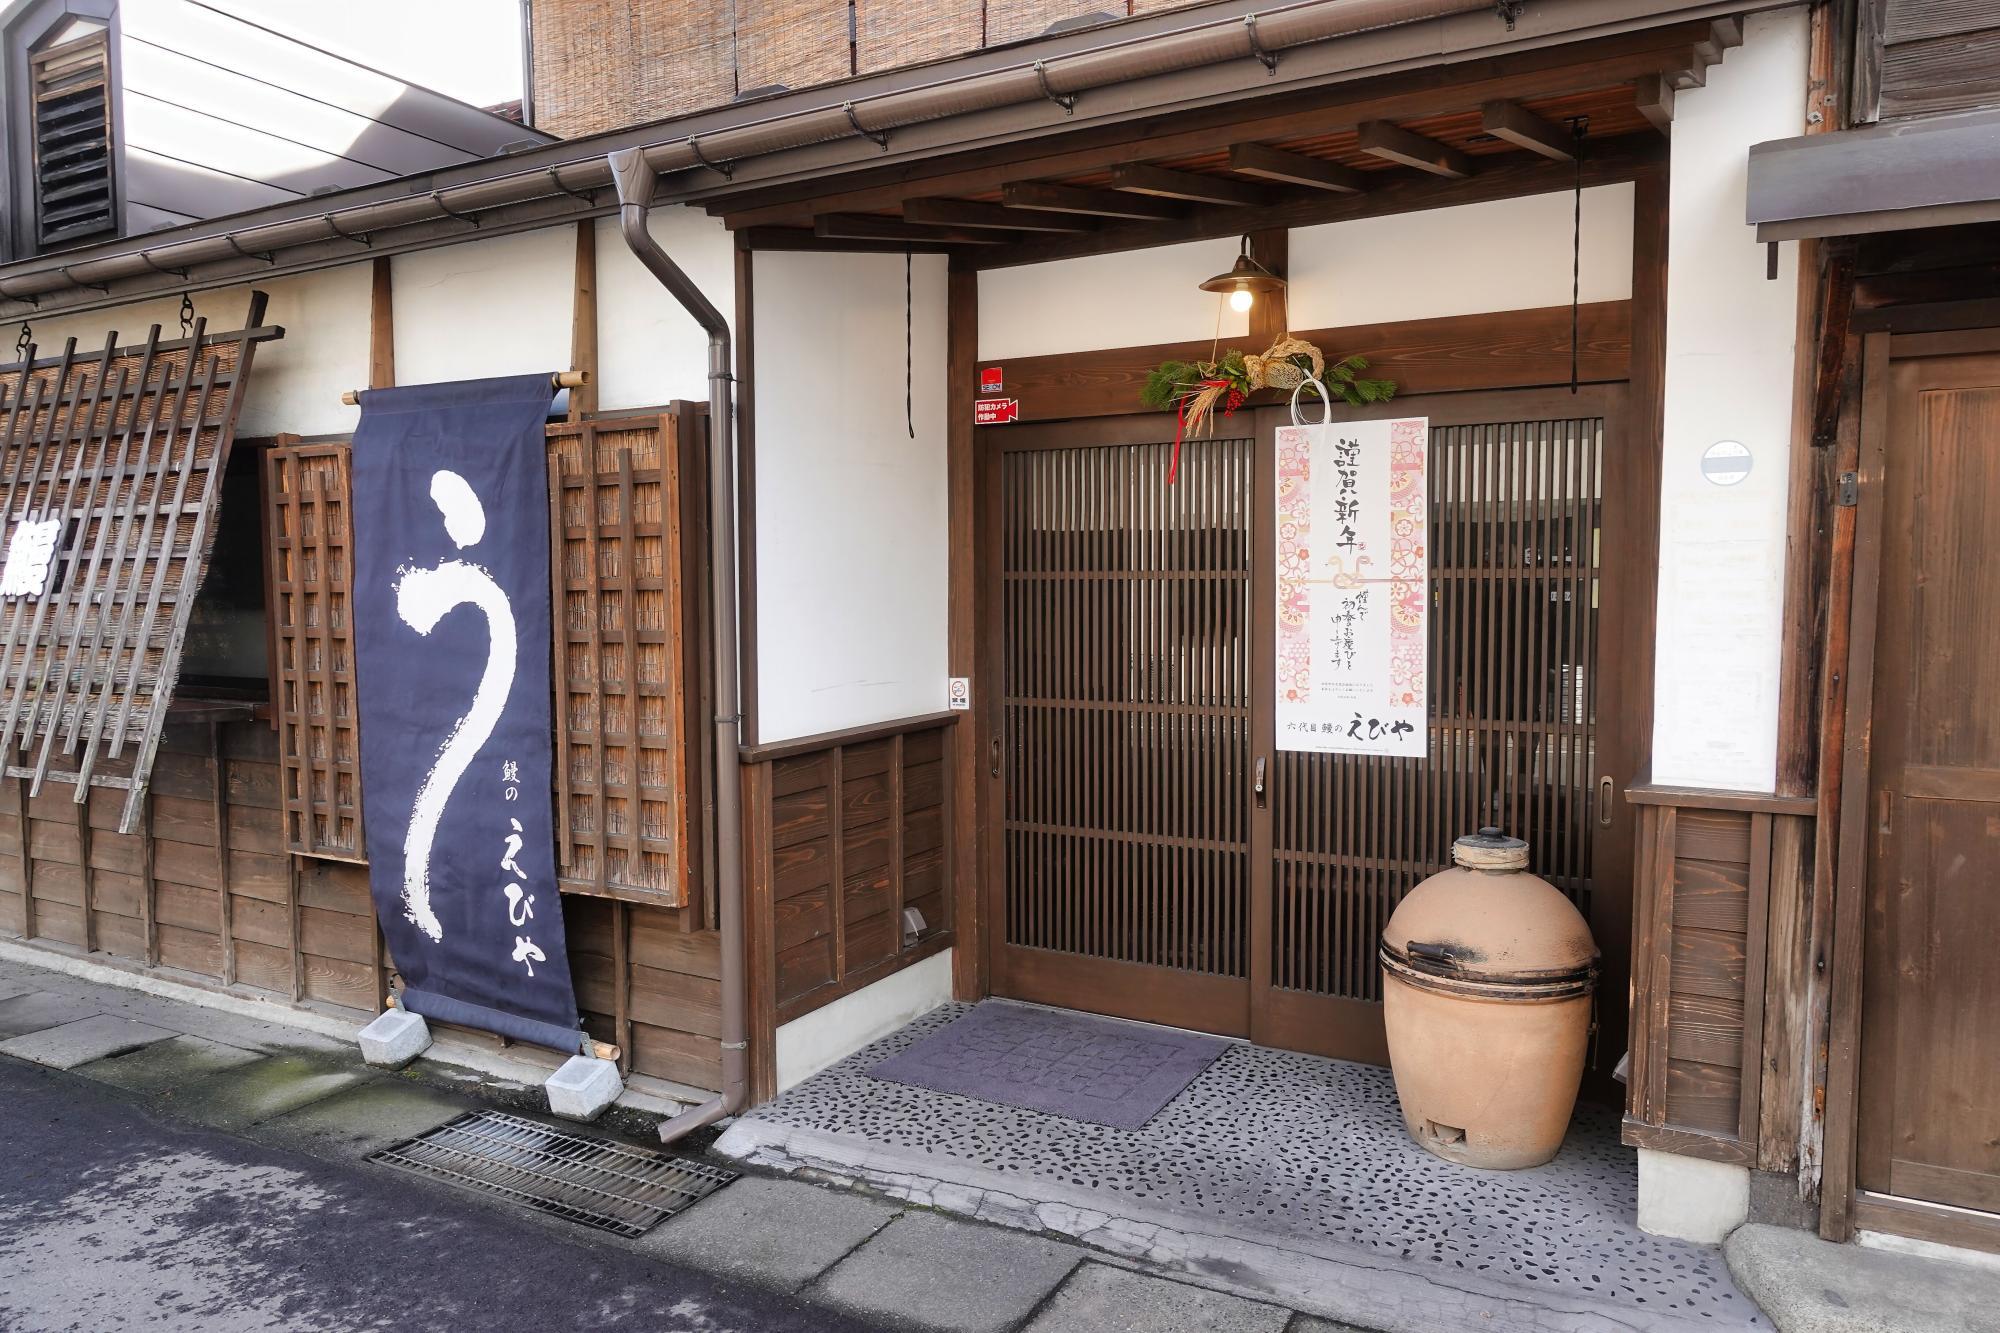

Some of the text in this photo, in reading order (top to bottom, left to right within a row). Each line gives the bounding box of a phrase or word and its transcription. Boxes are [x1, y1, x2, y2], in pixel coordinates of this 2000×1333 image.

[1333, 438, 1361, 555] 謹賀新年
[391, 469, 517, 944] う
[1287, 721, 1317, 733] 六代目
[1347, 711, 1414, 741] えびや
[500, 759, 547, 977] 鰻の えびや
